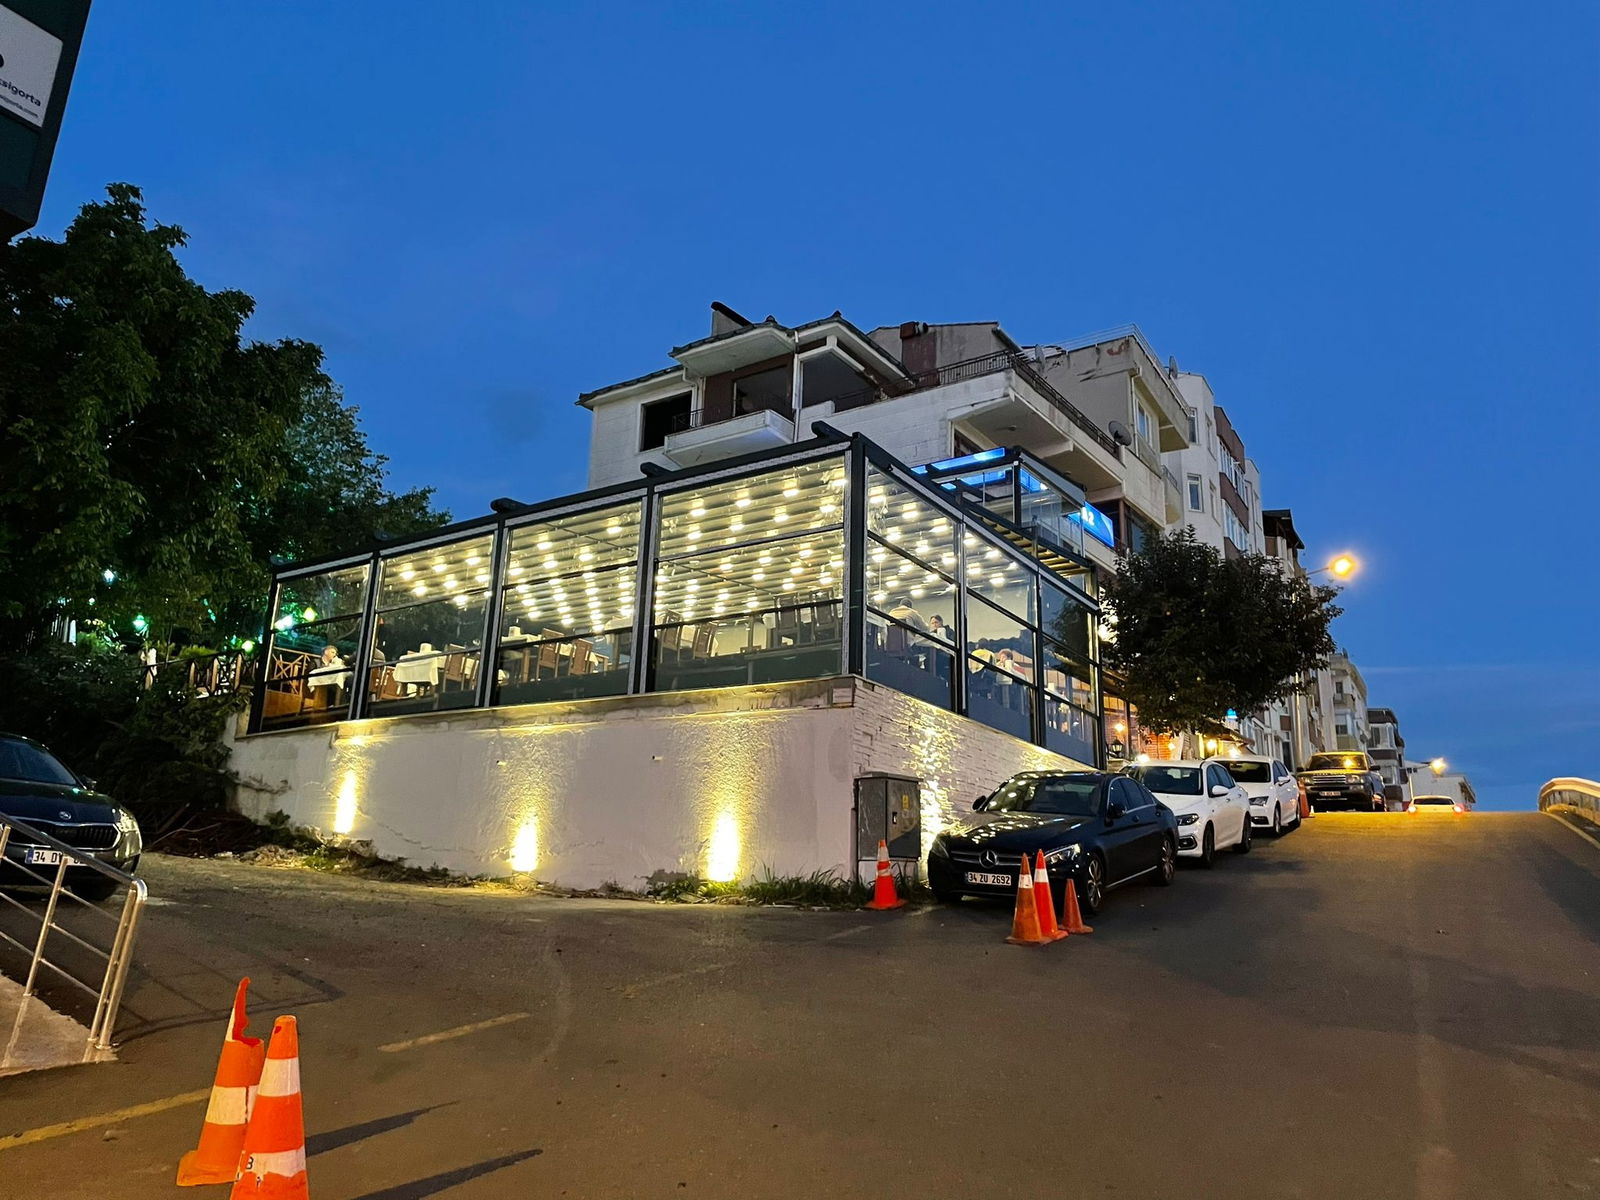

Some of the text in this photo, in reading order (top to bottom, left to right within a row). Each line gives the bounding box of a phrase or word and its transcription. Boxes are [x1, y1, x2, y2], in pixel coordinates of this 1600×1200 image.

[33, 851, 46, 862] 34
[969, 872, 1011, 885] 34 ZU 2692
